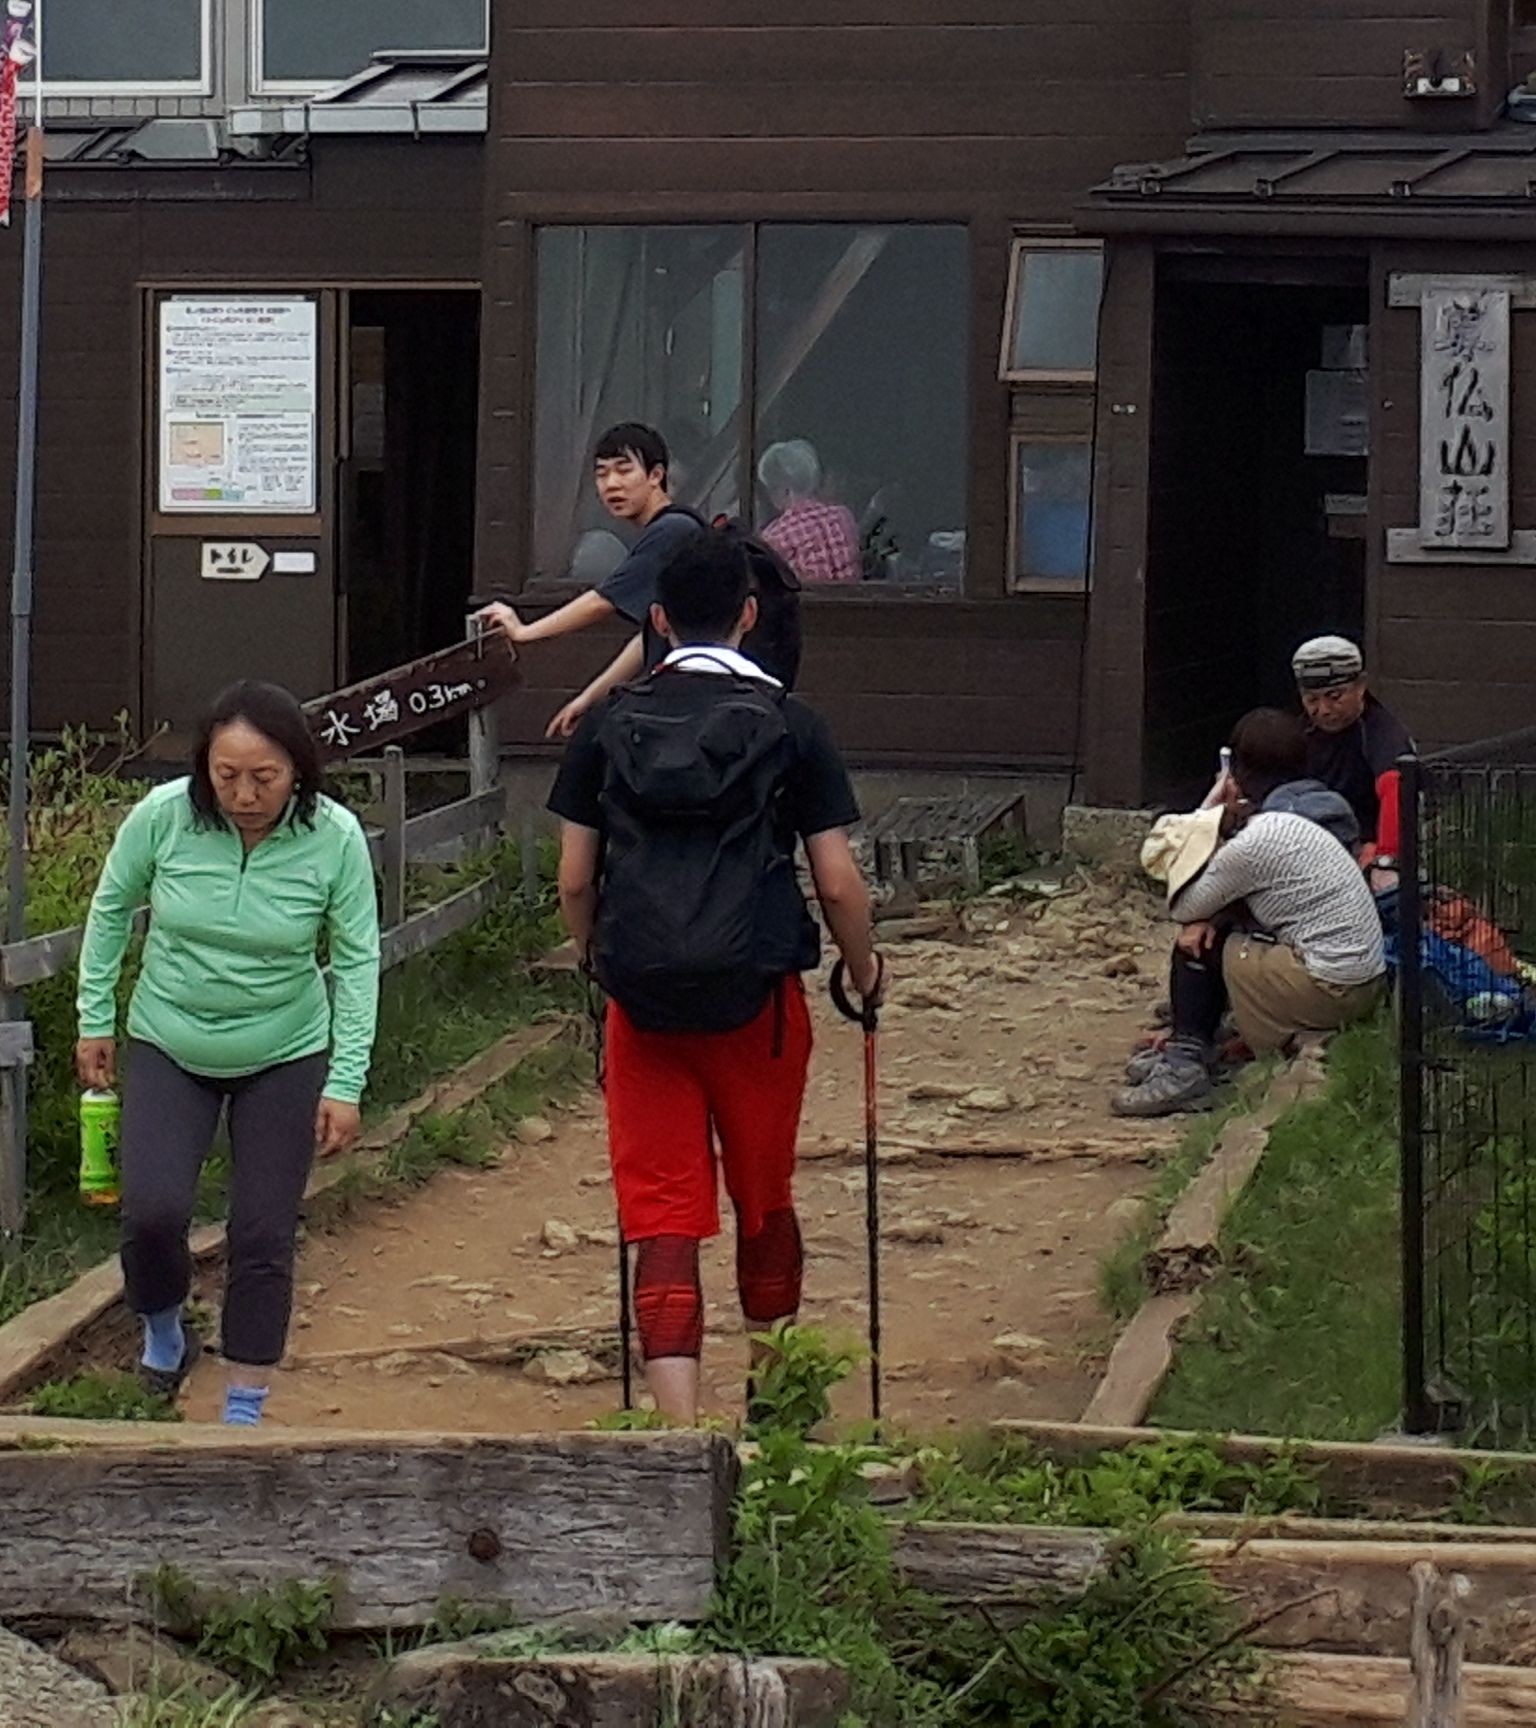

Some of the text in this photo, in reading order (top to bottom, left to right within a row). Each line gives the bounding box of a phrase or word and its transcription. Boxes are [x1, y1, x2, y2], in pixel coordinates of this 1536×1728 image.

[209, 546, 255, 564] トイレ
[320, 689, 399, 746] 水場
